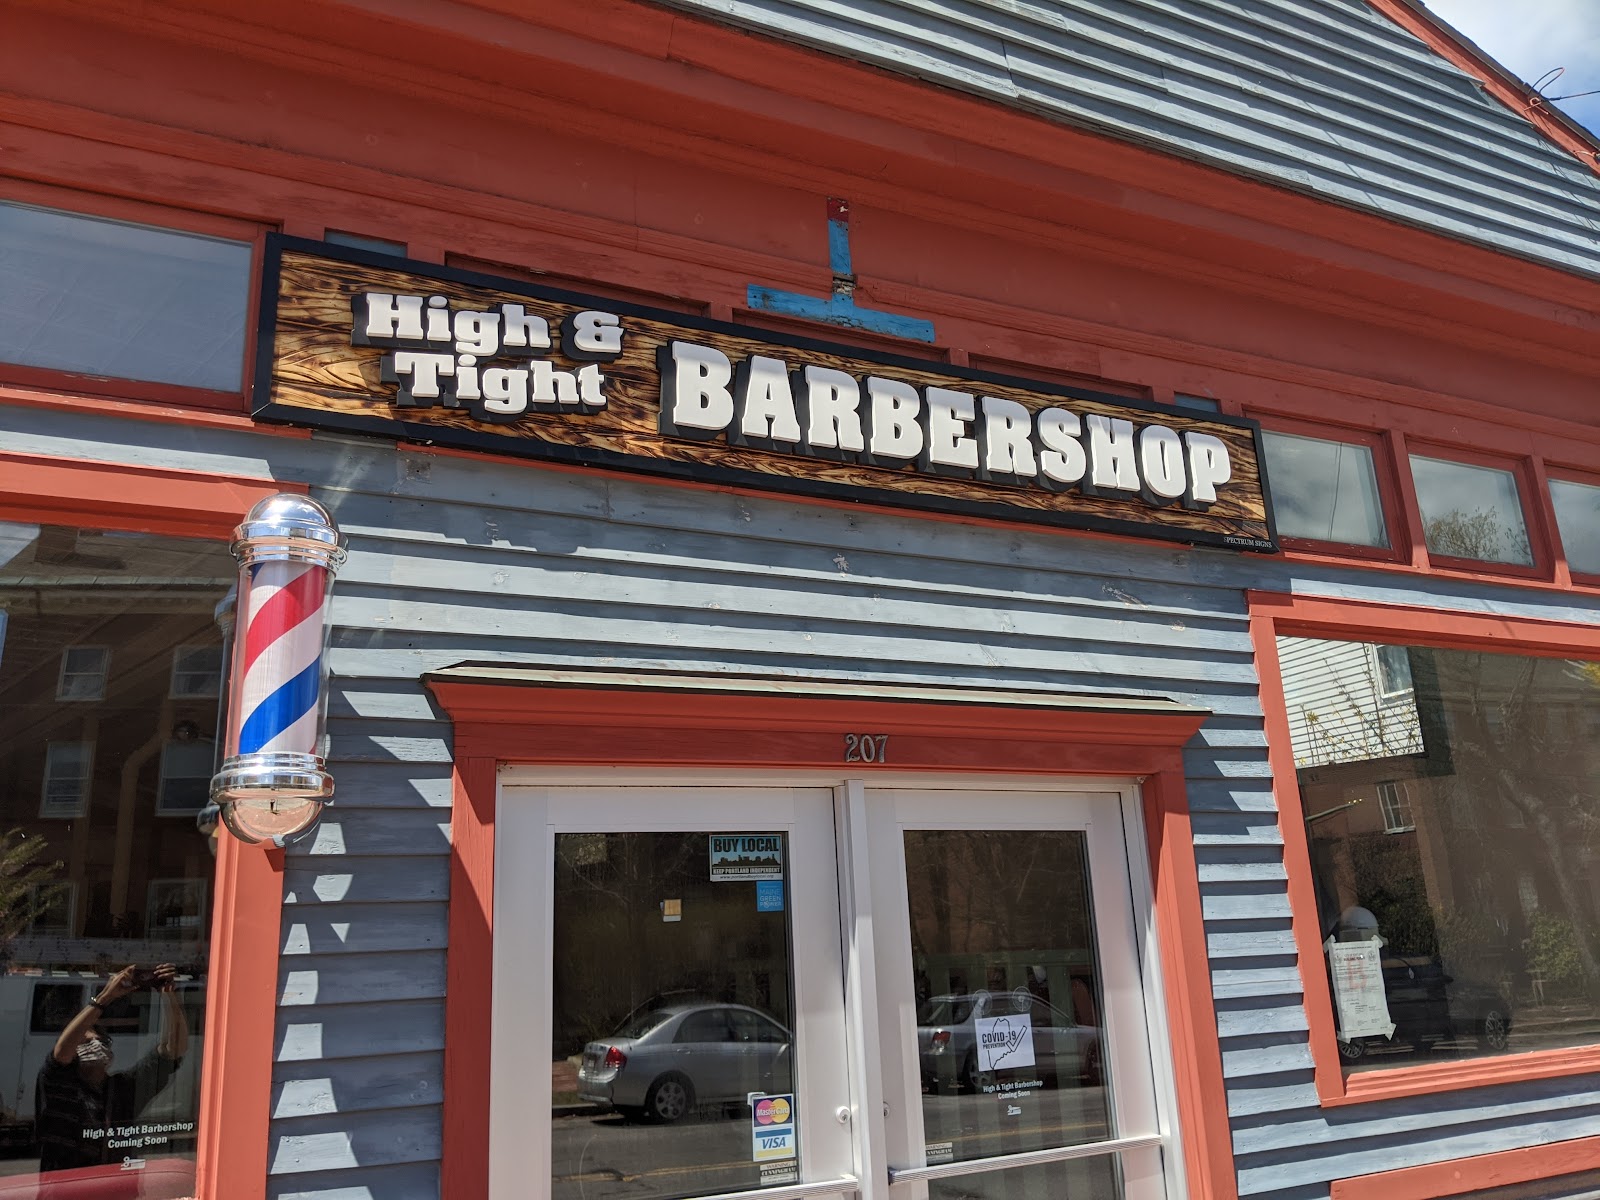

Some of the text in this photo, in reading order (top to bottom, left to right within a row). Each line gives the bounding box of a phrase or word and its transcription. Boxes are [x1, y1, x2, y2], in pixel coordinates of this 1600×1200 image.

[366, 292, 625, 357] High &
[394, 352, 607, 415] Tight
[671, 340, 1232, 504] BARBERSHOP
[1223, 536, 1273, 549] SPECTRUM SIGNS
[845, 733, 889, 763] 207
[713, 837, 779, 853] BUY LOCAL
[982, 1030, 1017, 1044] COVID-19
[982, 1042, 1006, 1050] PREVENTION
[983, 1079, 1043, 1094] High & Tight Barbershop
[997, 1089, 1031, 1100] Coming Soon
[757, 1107, 790, 1117] MasterCard
[83, 1122, 193, 1139] High & Tight Barbershop
[107, 1135, 168, 1149] Coming Soon
[762, 1137, 785, 1149] VISA
